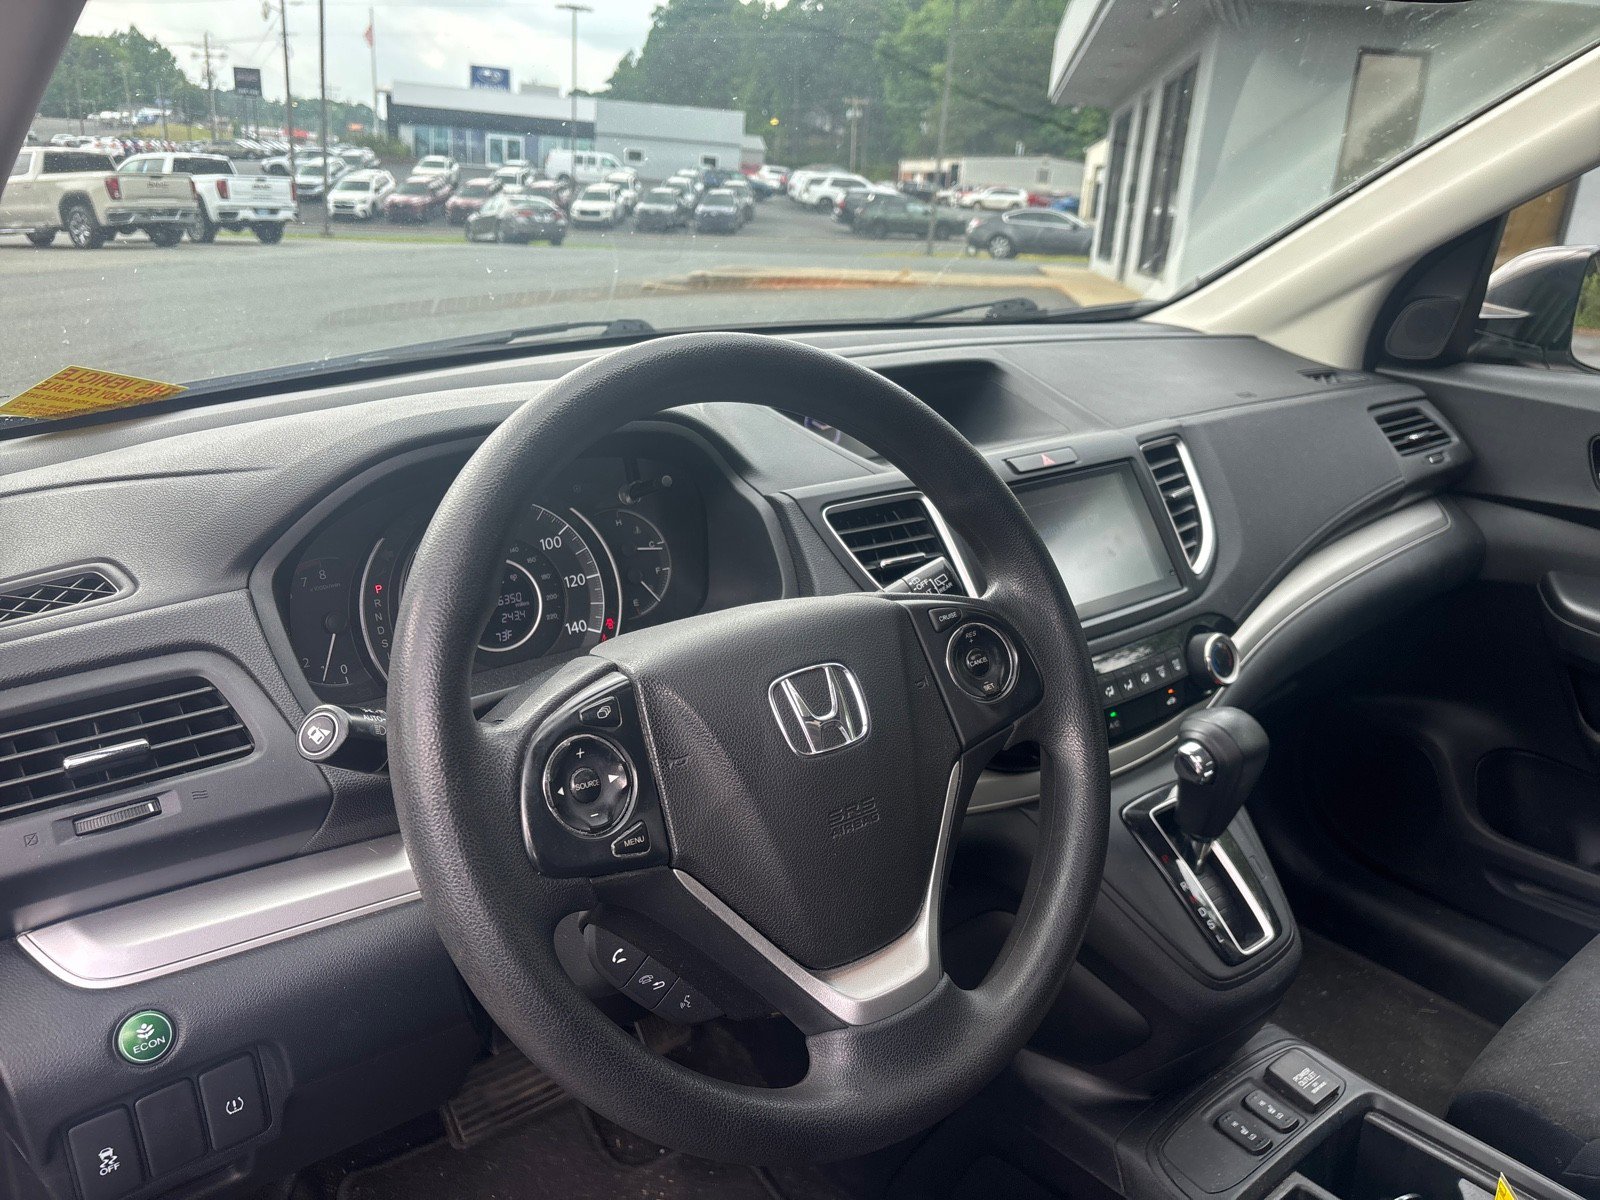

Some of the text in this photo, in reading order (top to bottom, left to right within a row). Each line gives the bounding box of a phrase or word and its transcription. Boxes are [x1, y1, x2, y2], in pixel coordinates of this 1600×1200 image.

[540, 536, 562, 551] 100
[318, 569, 327, 580] 8
[300, 577, 308, 588] 7
[564, 573, 586, 588] 120
[916, 579, 928, 590] OFF
[374, 584, 382, 594] P
[374, 599, 382, 607] R
[374, 612, 383, 621] N
[938, 611, 957, 622] CRUISE
[377, 626, 385, 635] D
[565, 620, 587, 635] 140
[965, 630, 977, 639] RES
[381, 639, 389, 648] S
[302, 658, 310, 668] 2
[340, 664, 348, 675] 0
[983, 683, 995, 691] SET
[363, 714, 383, 723] AUTO
[575, 779, 599, 791] SOURCE
[624, 835, 645, 847] MENU
[1197, 906, 1207, 918] D
[1206, 918, 1216, 930] S
[1215, 934, 1224, 943] L
[133, 1036, 166, 1055] ECON
[99, 1162, 121, 1176] OFF
